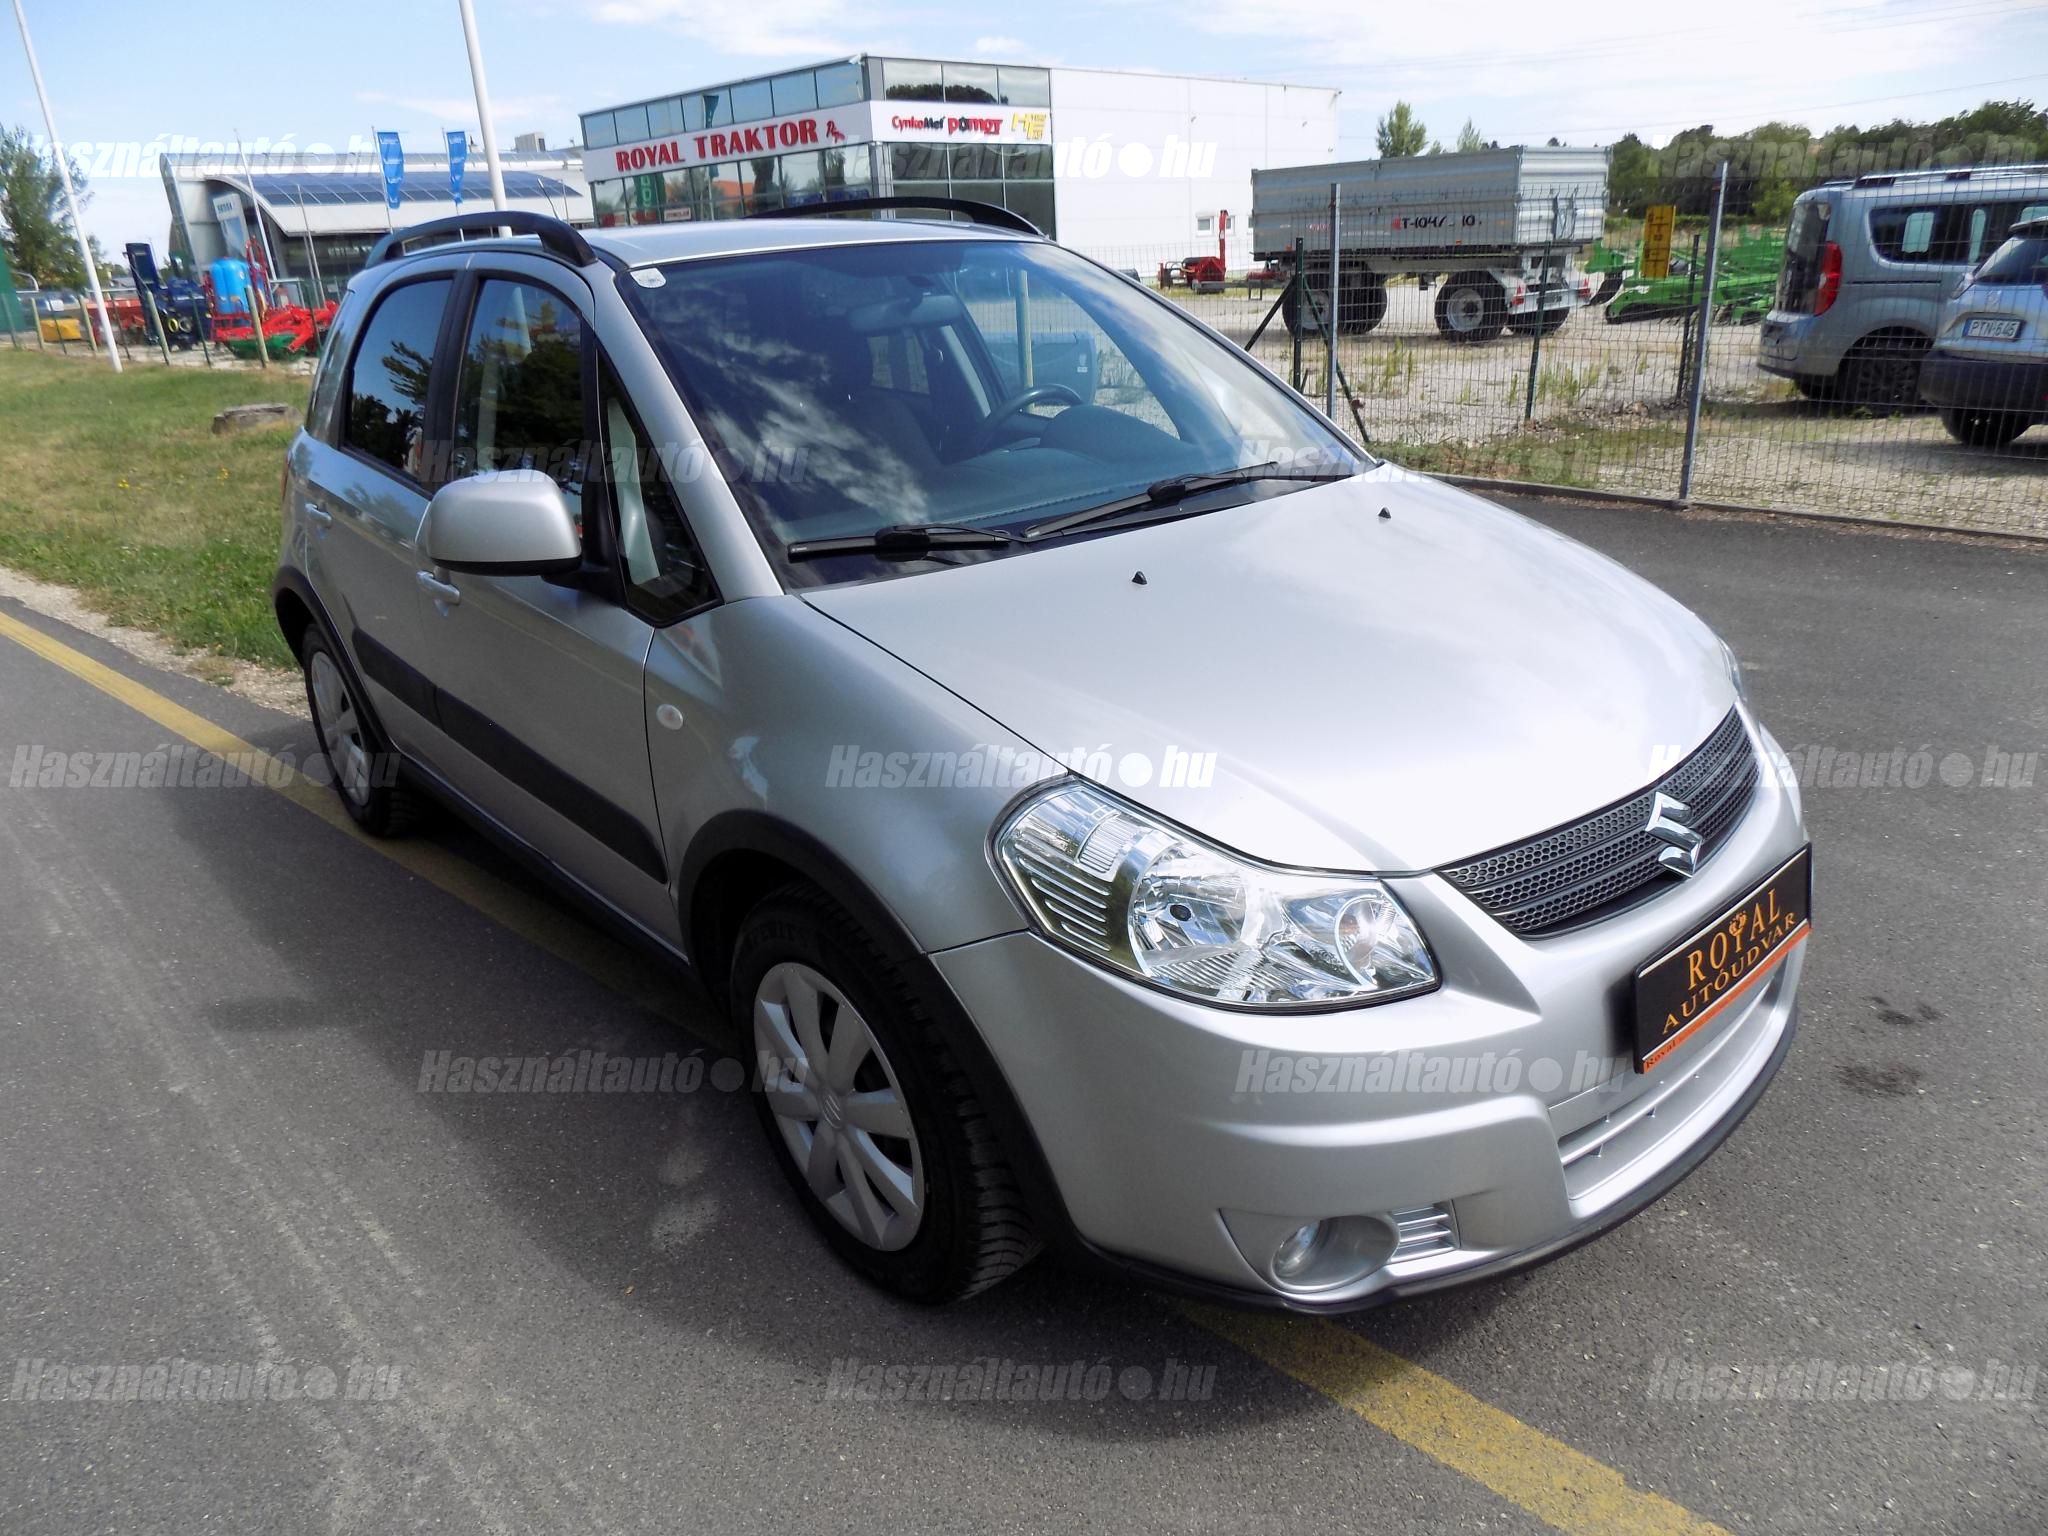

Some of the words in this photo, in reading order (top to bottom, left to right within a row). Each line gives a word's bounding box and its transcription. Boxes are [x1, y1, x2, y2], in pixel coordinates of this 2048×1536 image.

[616, 142, 685, 172] ROYAL
[694, 119, 819, 159] TRAKTOR
[1687, 888, 1781, 991] ROYAL
